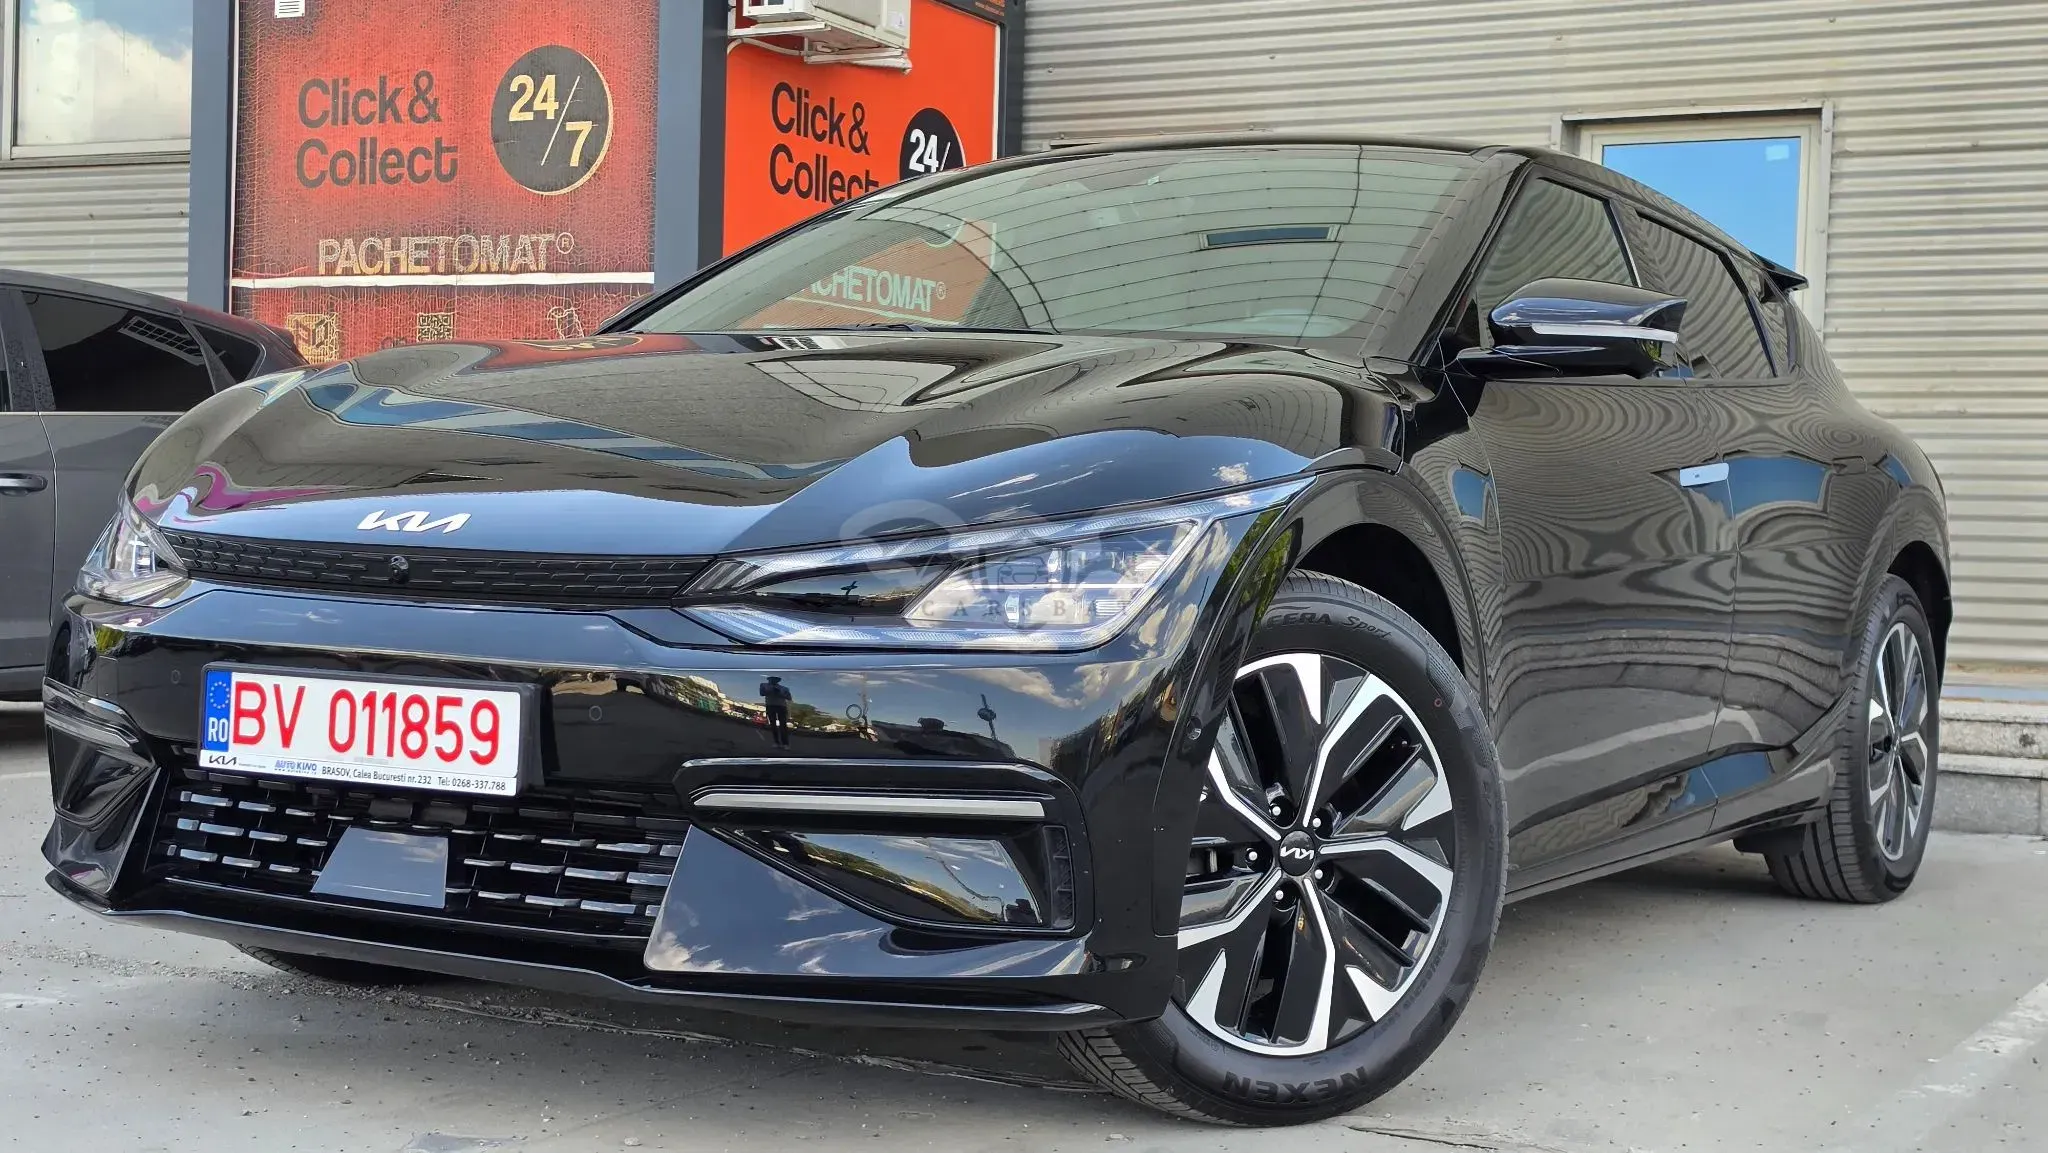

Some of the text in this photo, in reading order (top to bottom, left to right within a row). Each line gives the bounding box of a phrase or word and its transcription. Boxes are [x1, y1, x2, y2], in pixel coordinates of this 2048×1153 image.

[508, 73, 594, 167] 24/7
[296, 137, 459, 189] Collect
[1342, 615, 1392, 638] Sport
[208, 716, 229, 743] RO
[232, 680, 501, 766] BV 011859
[352, 769, 372, 780] Calea
[373, 769, 406, 783] Bucuresti
[438, 776, 450, 787] Tel:
[451, 777, 506, 791] 0268-337.788
[1222, 1066, 1369, 1104] NEXEN
